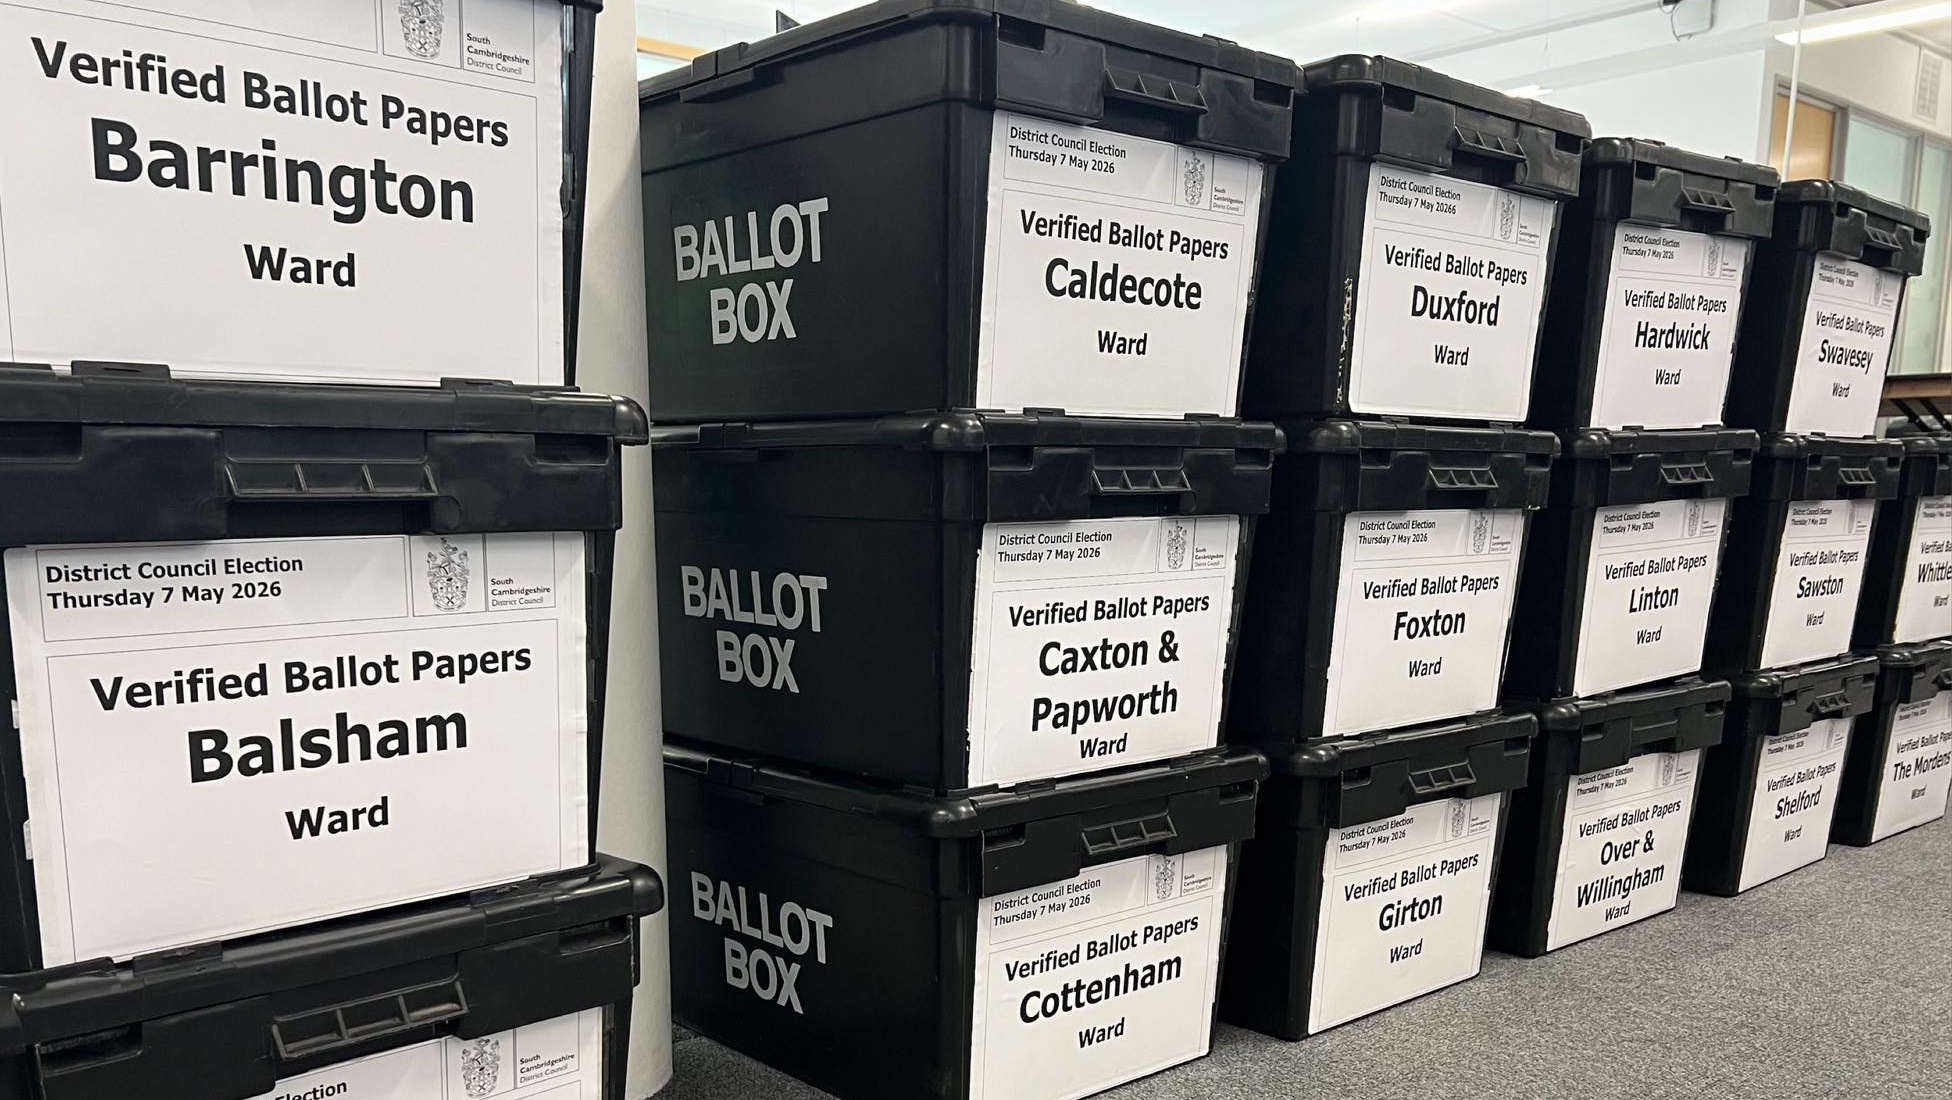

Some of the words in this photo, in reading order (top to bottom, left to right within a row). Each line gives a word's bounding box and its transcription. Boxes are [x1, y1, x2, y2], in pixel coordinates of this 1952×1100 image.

[466, 33, 491, 45] South
[467, 45, 529, 65] Cambridgeshire
[467, 57, 494, 70] District
[495, 62, 522, 75] Council
[30, 36, 226, 104] Verified
[243, 71, 368, 126] Ballot
[381, 94, 508, 147] Papers
[1010, 126, 1049, 145] District
[1051, 134, 1087, 151] Council
[1089, 141, 1126, 158] Election
[91, 117, 473, 224] Barrington
[1009, 145, 1058, 166] Thursday
[1060, 153, 1066, 165] 7
[1069, 155, 1089, 172] May
[1091, 159, 1115, 174] 2026
[1379, 191, 1413, 208] Thursday
[1414, 197, 1419, 207] 7
[1420, 199, 1434, 212] May
[1381, 176, 1407, 190] District
[1408, 182, 1434, 195] Council
[1435, 187, 1461, 201] Election
[674, 197, 829, 281] BALLOT
[1020, 209, 1102, 243] Verified
[1109, 222, 1164, 251] Ballot
[1169, 230, 1228, 260] Papers
[243, 244, 355, 287] Ward
[1385, 244, 1442, 272] Verified
[1445, 254, 1484, 278] Ballot
[1487, 261, 1527, 285] Papers
[1045, 258, 1202, 310] Caldecote
[710, 278, 797, 345] BOX
[1411, 285, 1500, 326] Duxford
[1625, 289, 1666, 308] Verified
[1667, 293, 1696, 311] Ballot
[1697, 295, 1727, 315] Papers
[1635, 321, 1711, 350] Hardwick
[1816, 311, 1845, 330] Verified
[1845, 316, 1864, 333] Ballot
[1865, 321, 1885, 338] Papers
[1098, 330, 1147, 356] Ward
[1435, 344, 1469, 366] Ward
[1818, 339, 1873, 374] Swavesey
[1655, 369, 1681, 385] Ward
[1832, 383, 1850, 398] Ward
[999, 534, 1036, 546] District
[1038, 532, 1073, 544] Council
[1075, 531, 1112, 543] Election
[1359, 534, 1391, 545] Thursday
[1392, 534, 1397, 543] 7
[1397, 534, 1411, 544] May
[1412, 533, 1428, 543] 2026
[1360, 521, 1386, 531] District
[1386, 520, 1410, 530] Council
[1411, 520, 1436, 529] Election
[998, 550, 1044, 563] Thursday
[1046, 549, 1052, 560] 7
[1055, 549, 1075, 561] May
[1077, 547, 1101, 558] 2026
[1605, 560, 1646, 580] Verified
[1647, 557, 1676, 575] Ballot
[1677, 555, 1707, 572] Papers
[1790, 551, 1818, 566] Verified
[1818, 551, 1838, 565] Ballot
[1838, 550, 1859, 564] Papers
[46, 563, 132, 583] District
[138, 559, 217, 579] Council
[224, 556, 303, 575] Election
[491, 578, 514, 586] South
[47, 588, 155, 609] Thursday
[161, 587, 174, 603] 7
[182, 585, 224, 604] May
[232, 581, 281, 599] 2026
[491, 586, 551, 596] Cambridgeshire
[681, 565, 828, 632] BALLOT
[1364, 578, 1417, 599] Verified
[1420, 576, 1458, 595] Ballot
[1460, 575, 1499, 595] Papers
[1629, 586, 1679, 613] Linton
[1797, 575, 1843, 599] Sawston
[491, 599, 517, 607] District
[518, 596, 543, 605] Council
[1009, 600, 1088, 627] Verified
[1094, 597, 1148, 621] Ballot
[1152, 596, 1209, 618] Papers
[1393, 609, 1465, 641] Foxton
[1806, 612, 1825, 626] Ward
[1637, 626, 1662, 645] Ward
[716, 630, 800, 694] BOX
[1039, 638, 1148, 676] Caxton
[1158, 630, 1180, 663] &
[90, 663, 268, 711] Verified
[284, 654, 400, 693] Ballot
[412, 648, 531, 684] Papers
[1409, 657, 1442, 678] Ward
[1032, 680, 1177, 734] Papworth
[188, 712, 467, 783] Balsham
[1080, 732, 1128, 759] Ward
[1767, 773, 1796, 792] Verified
[1796, 768, 1816, 784] Ballot
[1816, 762, 1836, 778] Papers
[1893, 761, 1912, 781] The
[1775, 785, 1822, 819] Shelford
[285, 796, 389, 840] Ward
[1340, 828, 1365, 841] District
[1366, 821, 1389, 835] Council
[1390, 817, 1414, 829] Election
[1579, 814, 1620, 838] Verified
[1621, 807, 1650, 827] Ballot
[1651, 801, 1681, 819] Papers
[1339, 840, 1370, 853] Thursday
[1372, 837, 1376, 846] 7
[1377, 836, 1390, 844] May
[1391, 829, 1406, 841] 2026
[1784, 825, 1802, 842] Ward
[1601, 839, 1640, 865] Over
[1643, 830, 1654, 853] &
[1345, 872, 1397, 901] Verified
[1401, 863, 1437, 887] Ballot
[1440, 854, 1479, 876] Papers
[1578, 865, 1664, 908] Willingham
[994, 895, 1029, 911] District
[1031, 886, 1064, 903] Council
[1067, 879, 1101, 894] Election
[691, 871, 833, 964] BALLOT
[993, 909, 1038, 926] Thursday
[1040, 905, 1046, 915] 7
[1048, 902, 1066, 913] May
[1069, 894, 1090, 908] 2026
[1379, 895, 1442, 931] Girton
[1605, 900, 1631, 922] Ward
[1005, 944, 1080, 981] Verified
[1087, 930, 1138, 960] Ballot
[1143, 916, 1198, 944] Papers
[1390, 938, 1423, 963] Ward
[724, 937, 806, 1014] BOX
[1020, 956, 1181, 1023] Cottenham
[1079, 1017, 1125, 1049] Ward
[520, 1054, 541, 1065] South
[520, 1054, 575, 1074] Cambridgeshire
[544, 1063, 568, 1076] Council
